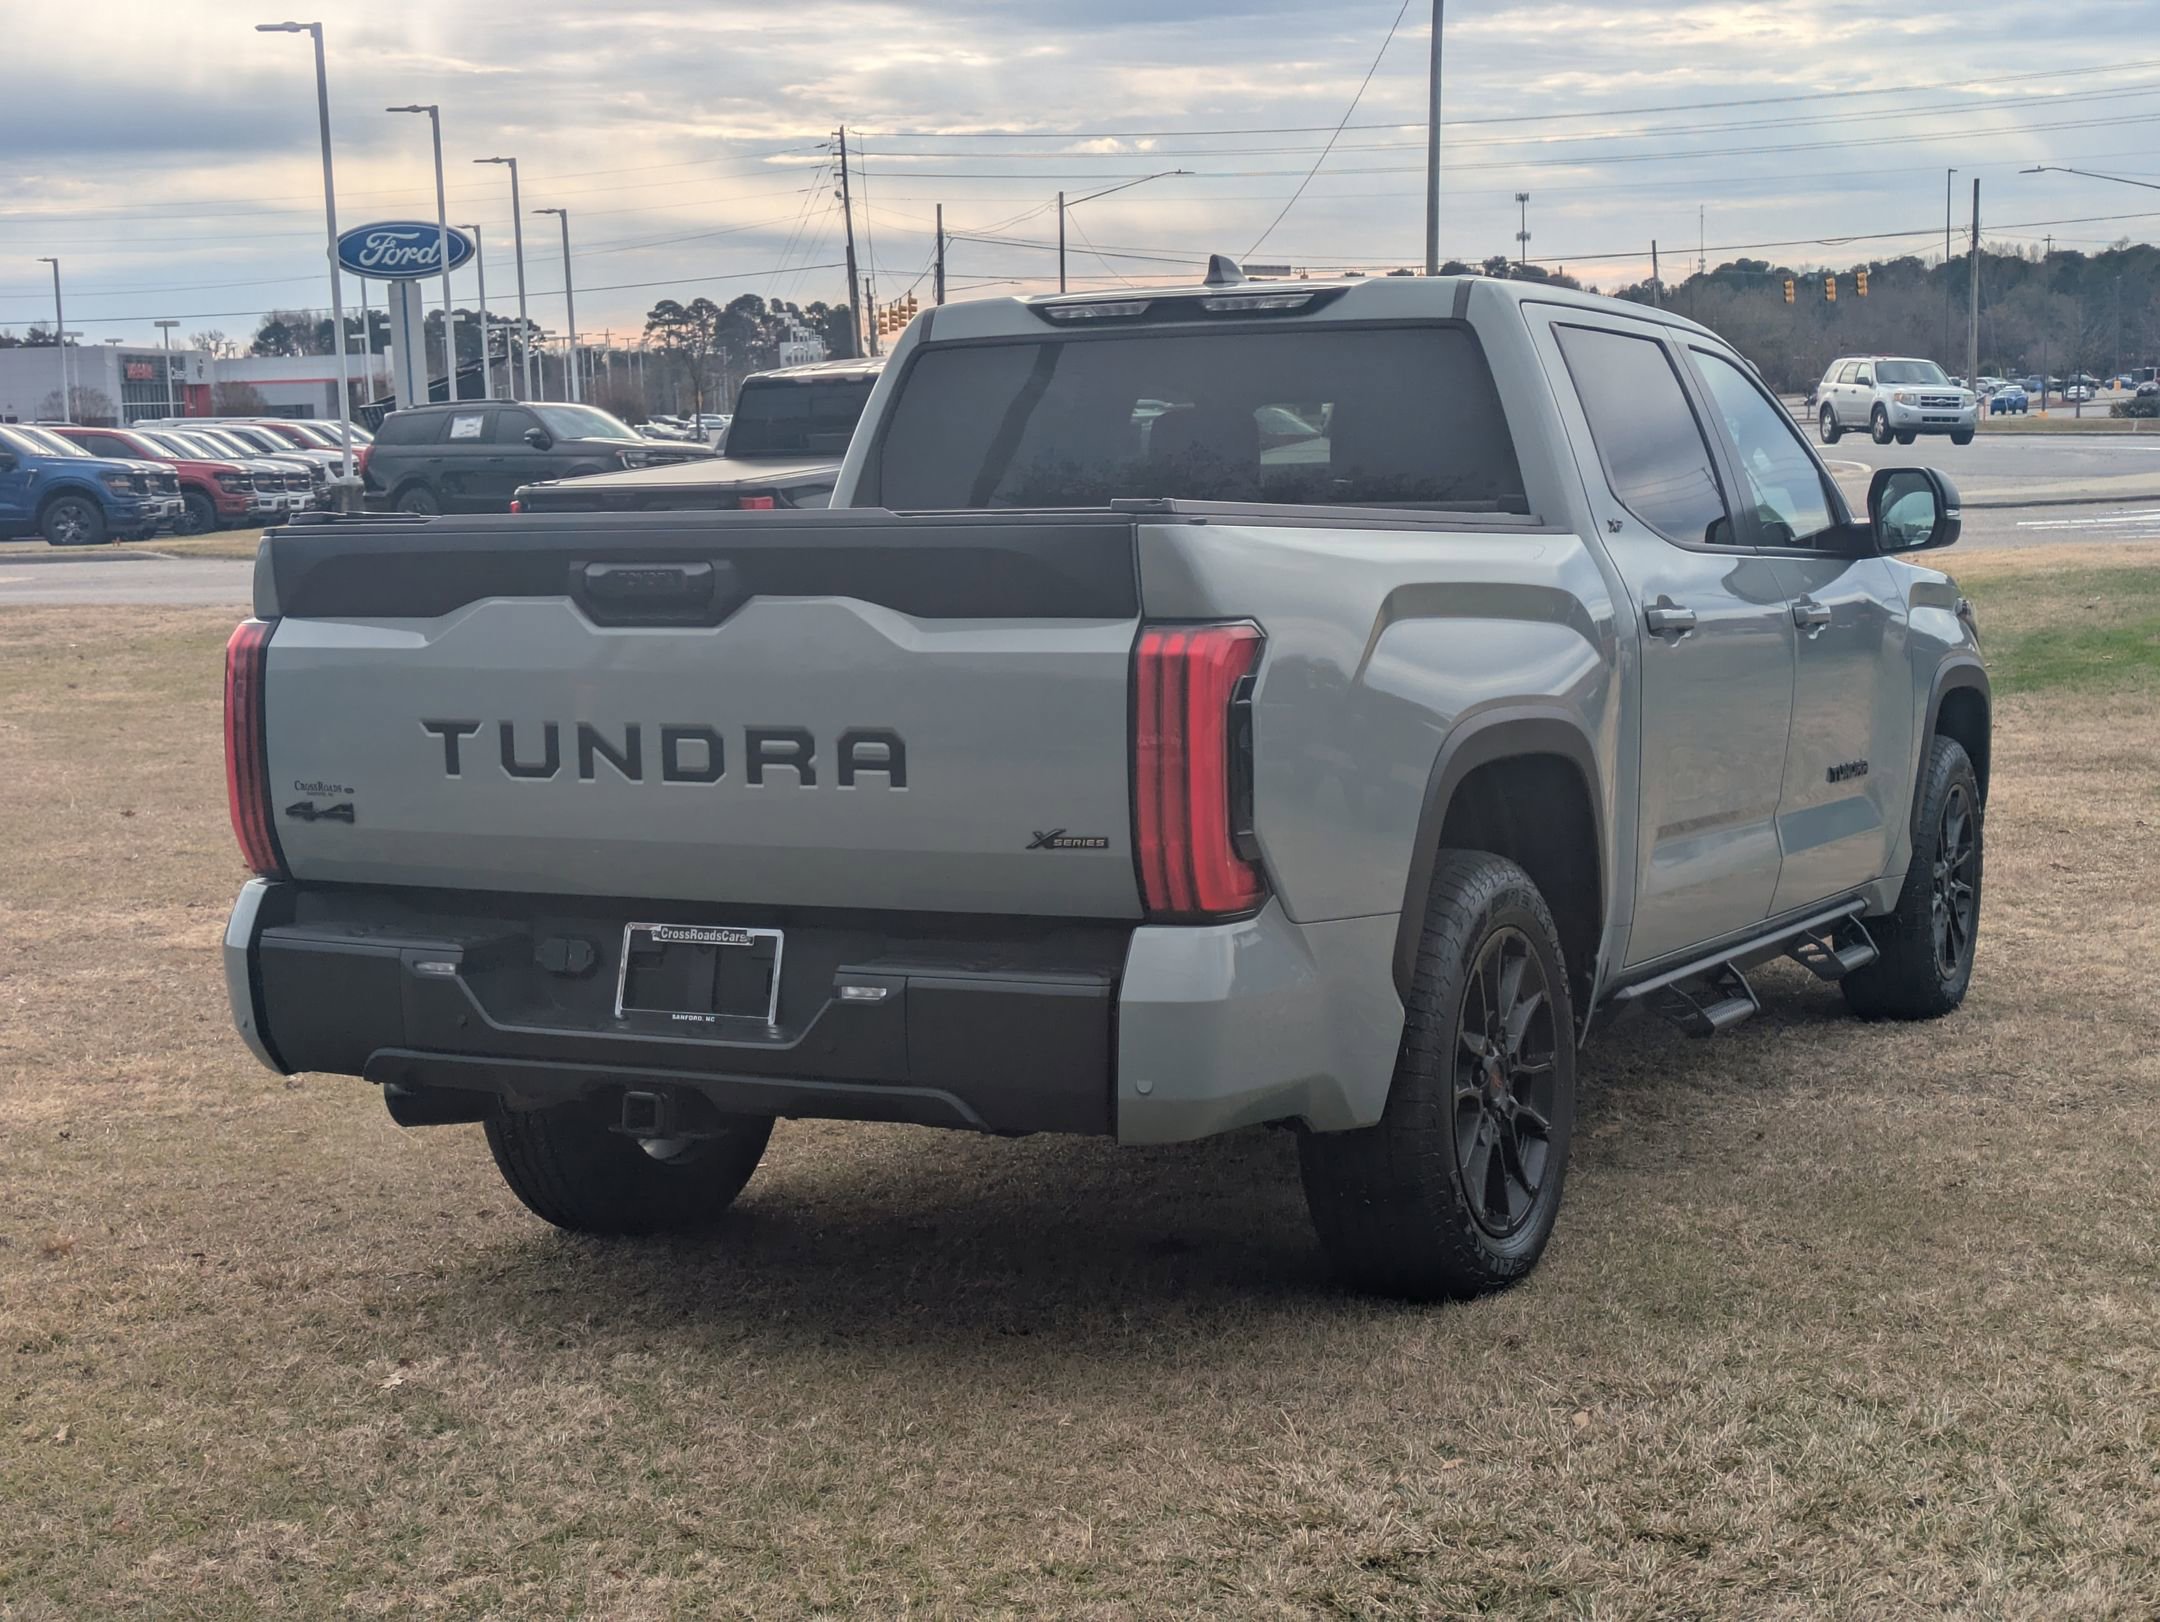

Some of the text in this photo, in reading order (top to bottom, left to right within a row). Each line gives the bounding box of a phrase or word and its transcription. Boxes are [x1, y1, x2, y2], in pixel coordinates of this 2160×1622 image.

[359, 232, 441, 266] Ford
[420, 719, 909, 792] TUNDRA
[1053, 838, 1105, 847] SERIES
